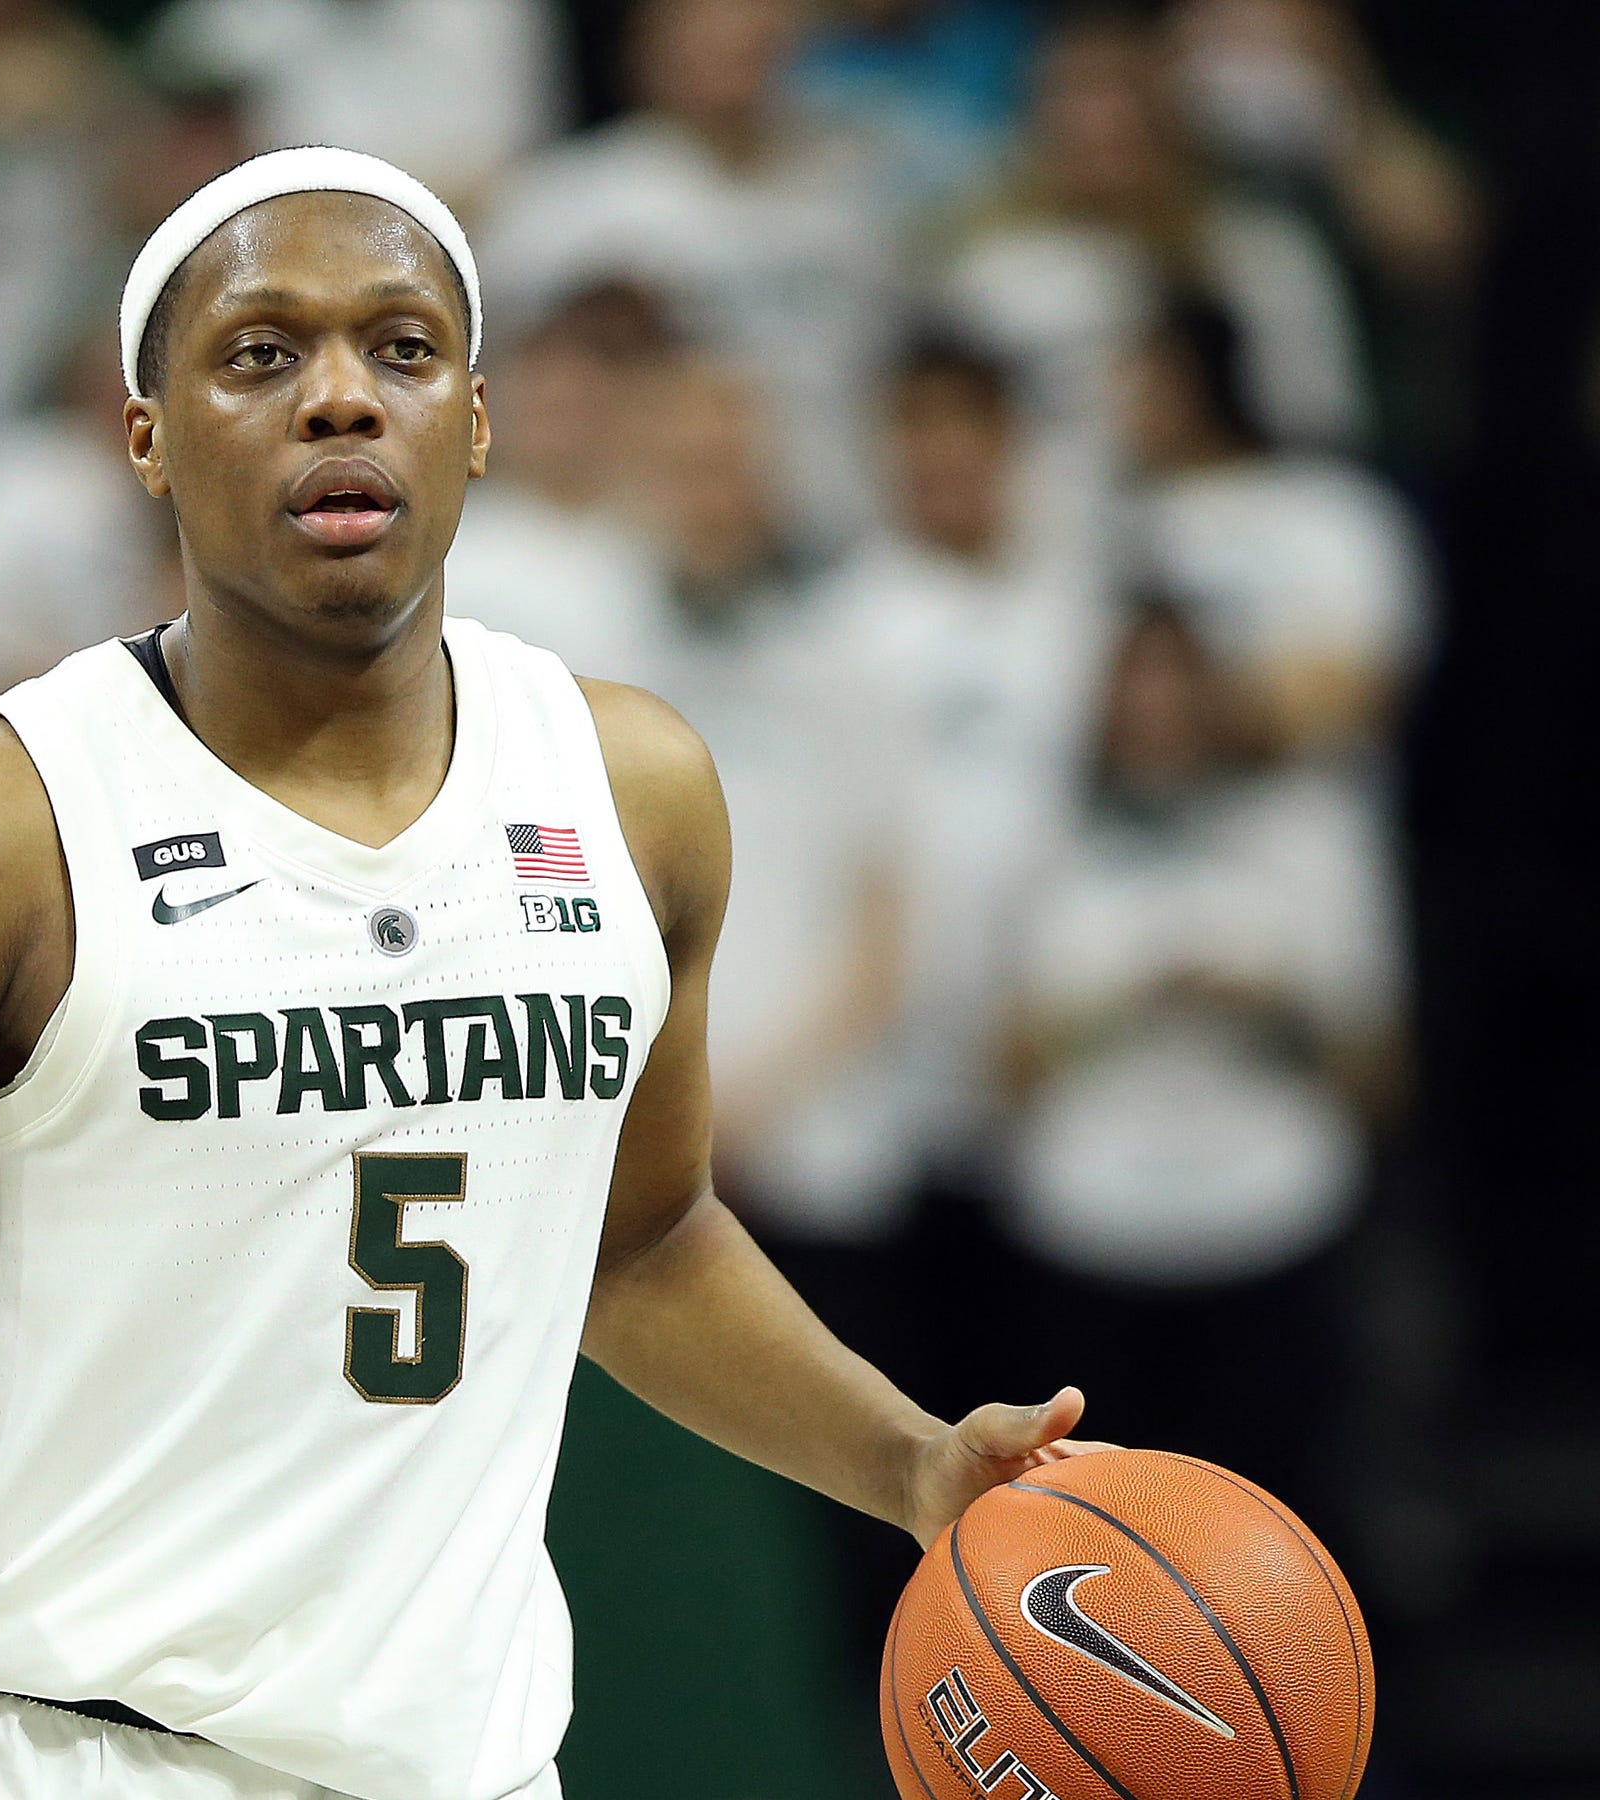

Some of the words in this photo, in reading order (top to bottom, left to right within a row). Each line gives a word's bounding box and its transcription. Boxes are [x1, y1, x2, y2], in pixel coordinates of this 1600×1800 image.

[152, 841, 207, 866] GUS
[135, 993, 632, 1121] SPARTANS
[343, 1151, 469, 1405] 5
[926, 1665, 1062, 1800] ELIT
